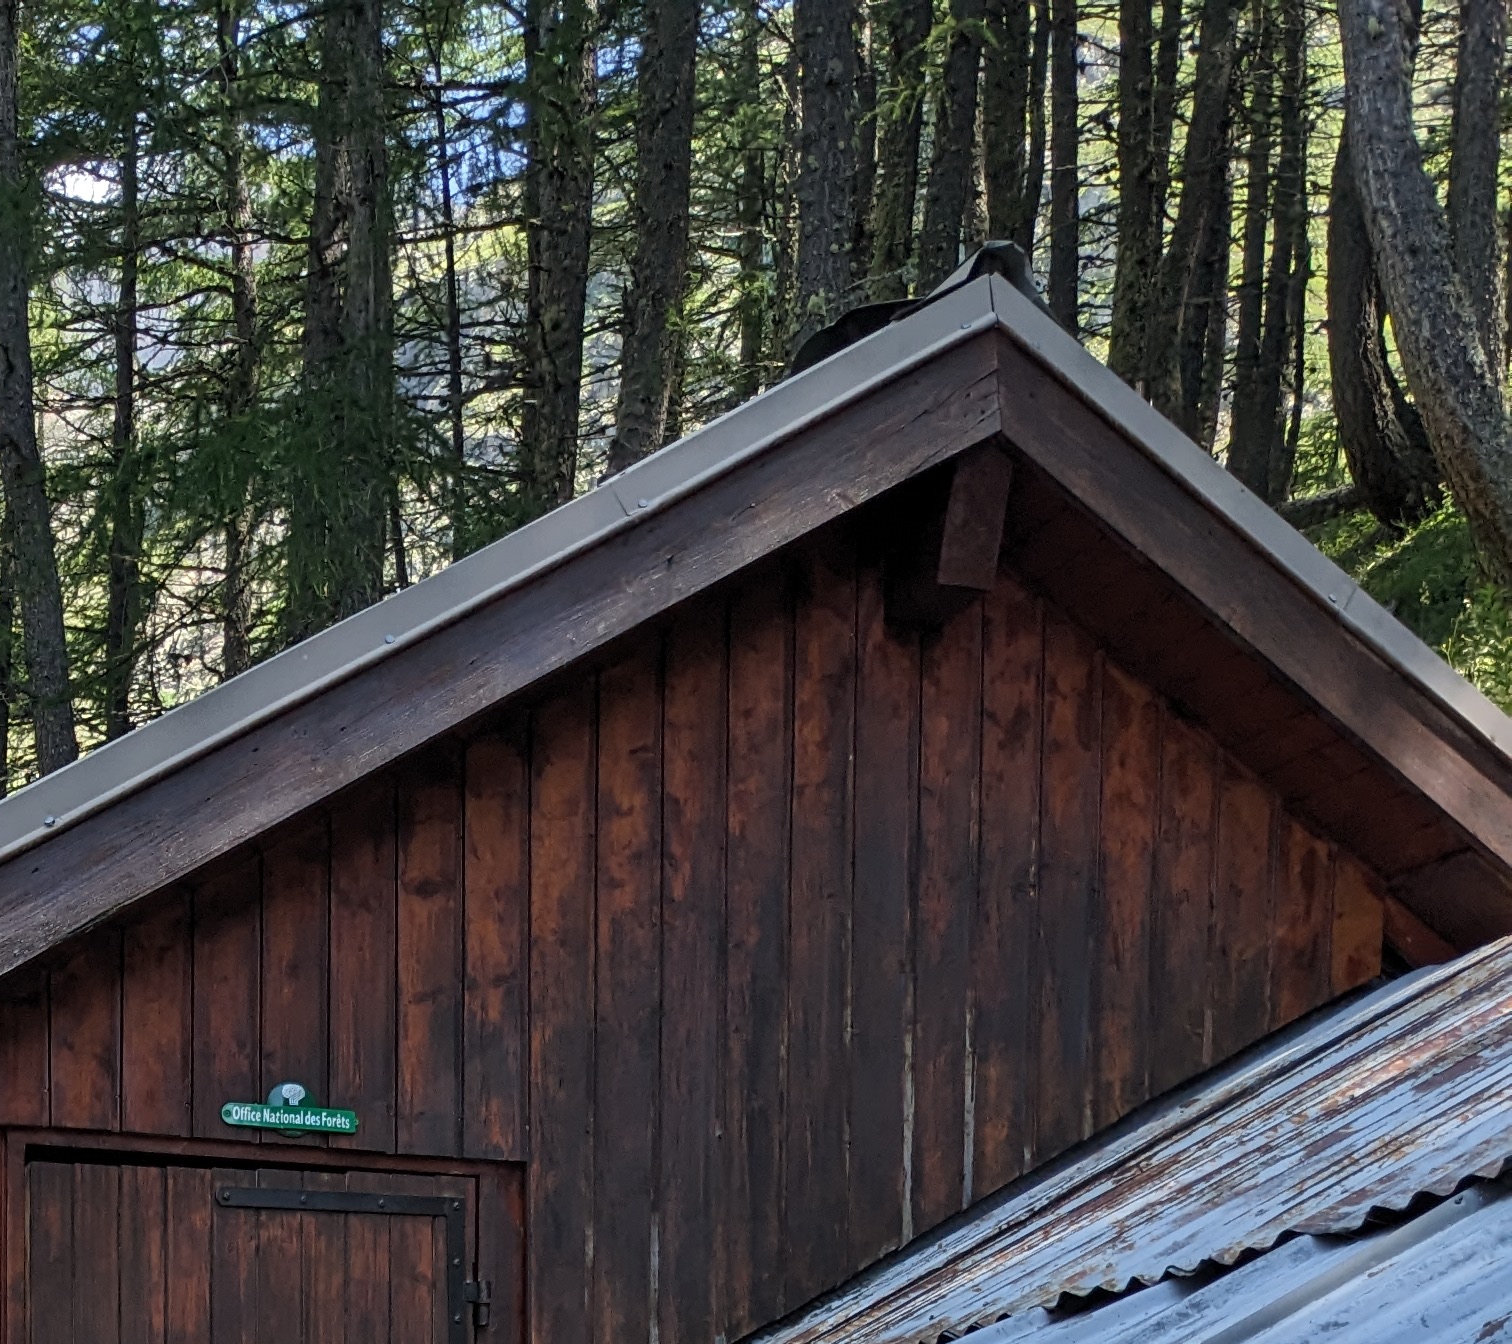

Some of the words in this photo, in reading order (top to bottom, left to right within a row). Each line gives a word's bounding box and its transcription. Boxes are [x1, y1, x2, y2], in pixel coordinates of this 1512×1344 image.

[232, 1106, 261, 1122] Office
[263, 1108, 304, 1125] National
[304, 1110, 320, 1126] des
[321, 1112, 350, 1129] Forêts
